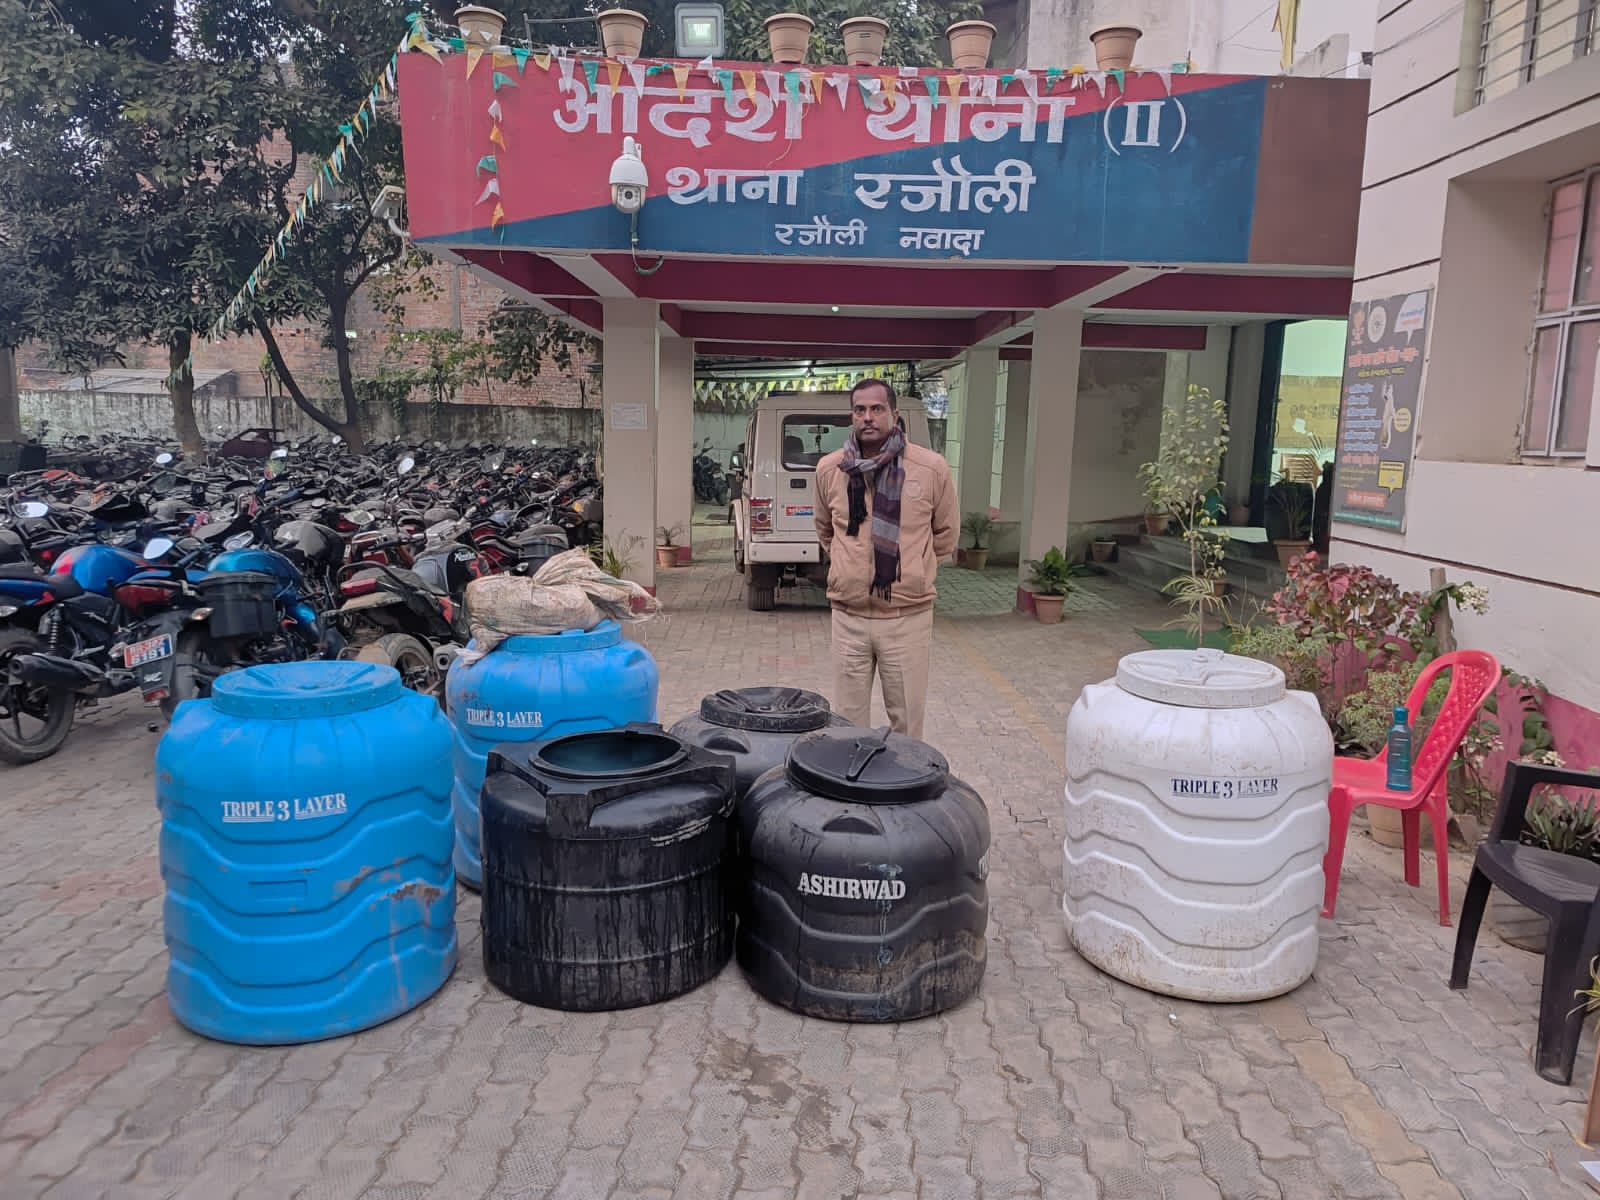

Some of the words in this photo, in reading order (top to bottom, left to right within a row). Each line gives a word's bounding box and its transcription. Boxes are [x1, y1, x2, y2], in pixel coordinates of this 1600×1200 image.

[865, 92, 1076, 143] थाना
[665, 166, 804, 206] थाना
[854, 154, 1037, 214] रजौली
[774, 215, 868, 247] रजौली
[900, 226, 985, 257] नवादा
[496, 711, 504, 727] 3
[506, 711, 542, 726] LAYER
[1171, 778, 1220, 796] TRIPLE
[1223, 780, 1233, 799] 3
[1237, 778, 1278, 796] LAYER
[221, 801, 274, 820] TRIPLE
[277, 800, 290, 821] 3
[294, 793, 347, 818] LAYER
[797, 872, 906, 900] ASHIRWAD
